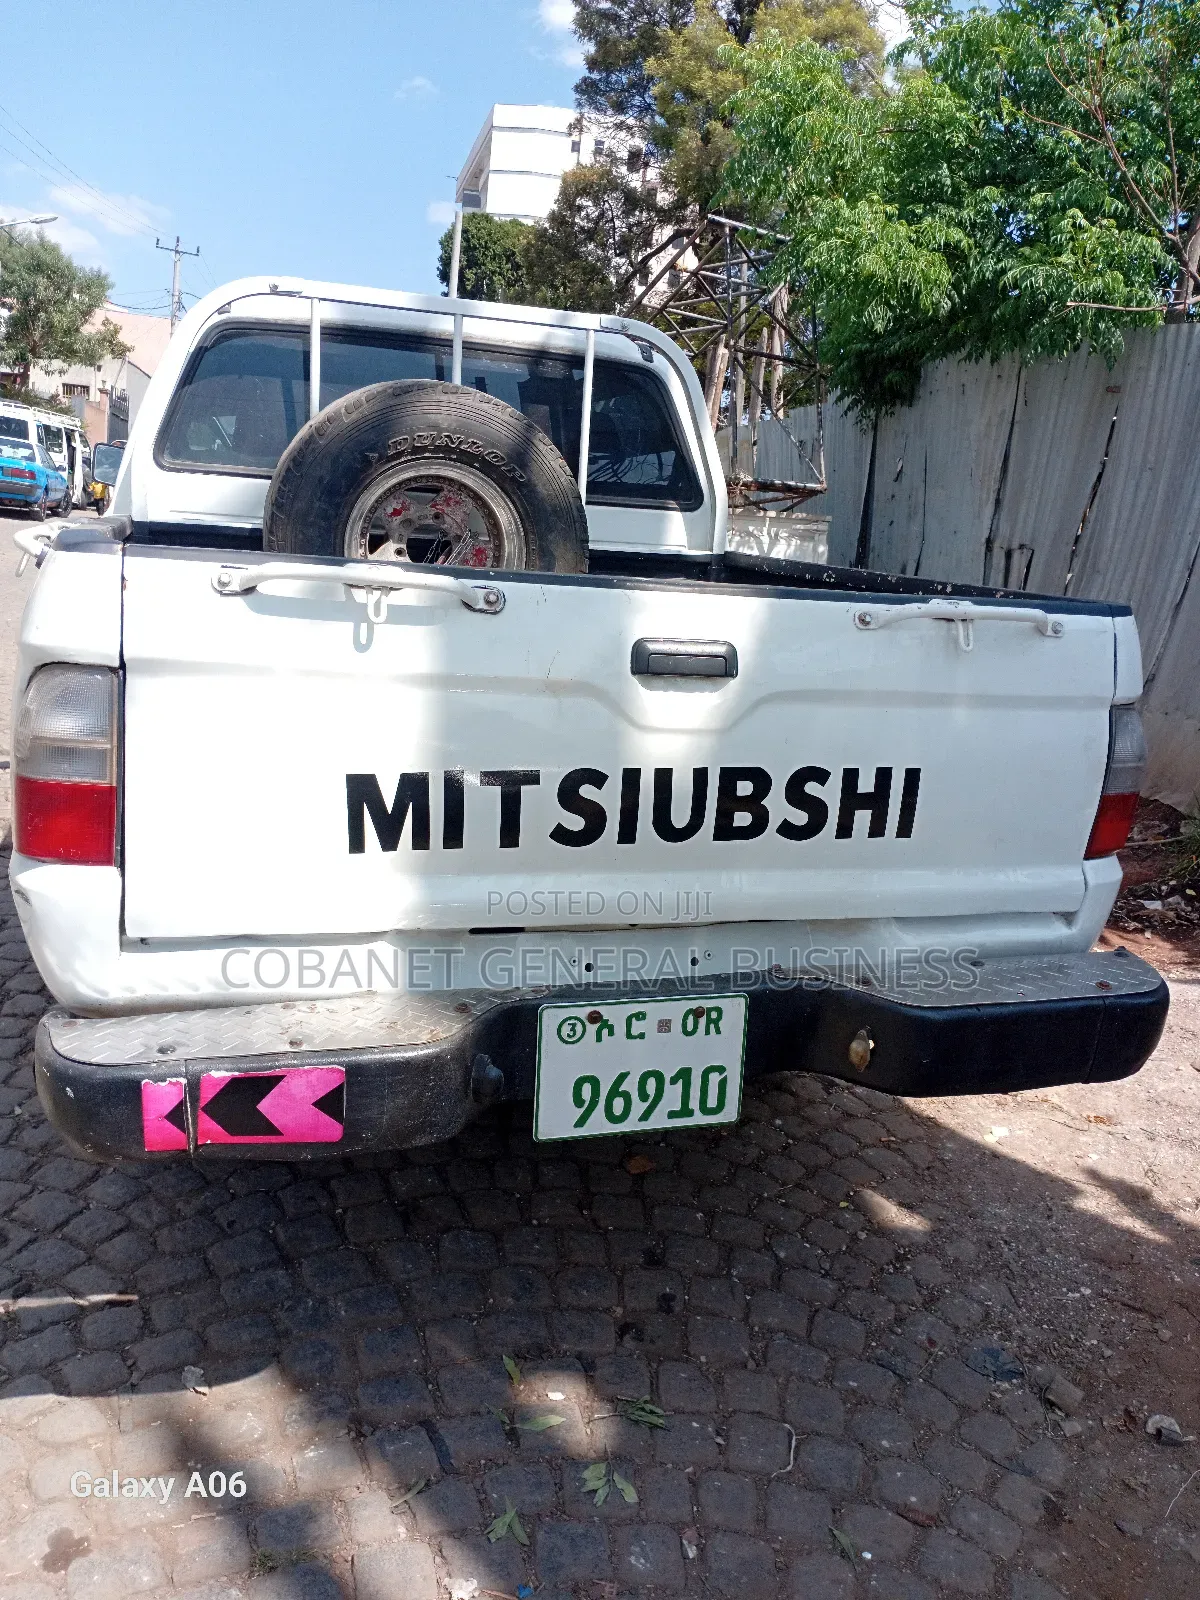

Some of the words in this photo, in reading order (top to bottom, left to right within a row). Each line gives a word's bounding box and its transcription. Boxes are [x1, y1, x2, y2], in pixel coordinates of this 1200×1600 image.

[388, 432, 526, 482] DUNLOP
[346, 766, 921, 854] MITSIUBSHI
[681, 1006, 724, 1037] OR
[572, 1064, 728, 1129] 96910
